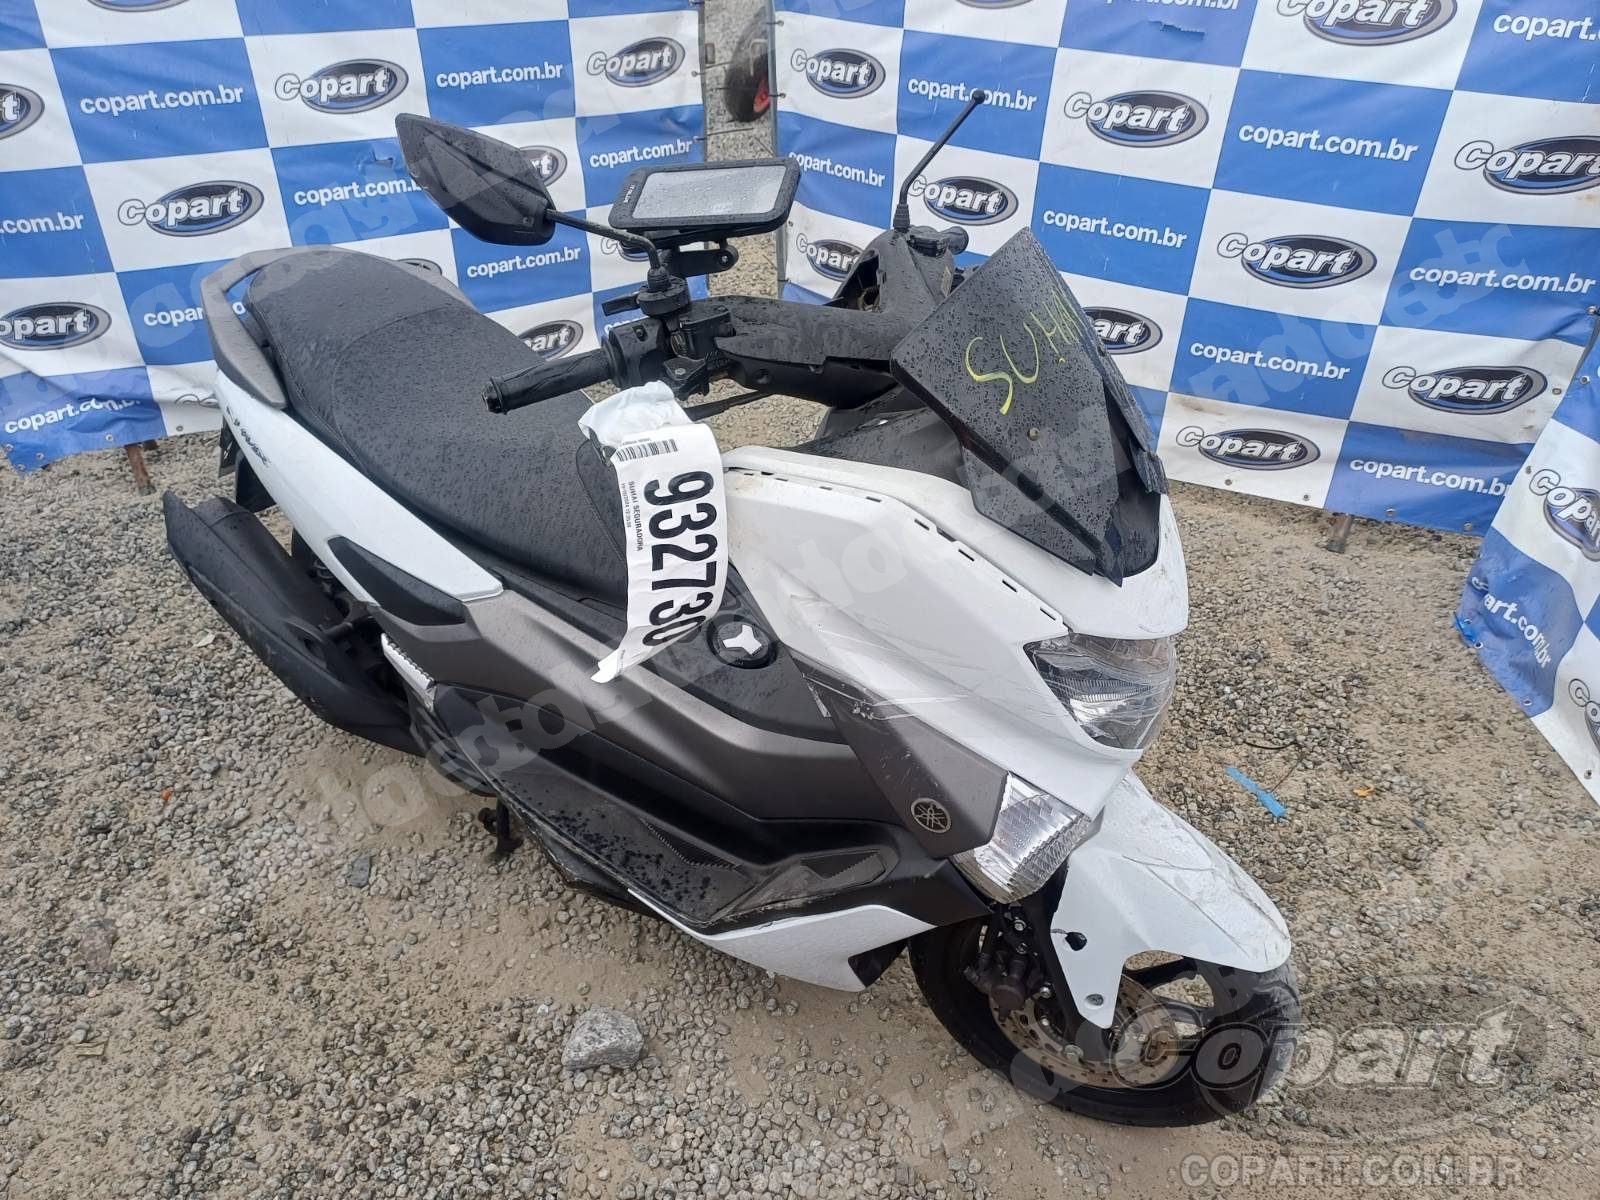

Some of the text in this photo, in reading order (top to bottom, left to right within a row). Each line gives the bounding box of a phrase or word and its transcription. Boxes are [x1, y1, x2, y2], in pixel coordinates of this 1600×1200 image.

[1493, 14, 1600, 41] copart.
[436, 62, 563, 90] copart.com.br
[586, 45, 673, 76] Copart
[790, 48, 872, 86] Copart
[80, 84, 244, 117] copart.com.br
[274, 66, 390, 105] Copart
[1063, 91, 1190, 134] Copart
[590, 138, 693, 168] copart.com.br
[1238, 124, 1418, 162] copart.com.br
[118, 187, 244, 227] Copart
[907, 174, 1003, 217] Copart
[1043, 209, 1188, 248] copart.com.br
[467, 246, 582, 278] copart.com.br
[796, 233, 861, 272] Copar
[1216, 232, 1356, 274] Copart
[1409, 266, 1596, 294] copart.com.br
[1190, 342, 1350, 380] copart.com.br
[1382, 366, 1529, 402] Copart
[1175, 425, 1303, 461] Copart
[632, 504, 644, 551] SEGURADORA
[642, 470, 718, 647] 932730
